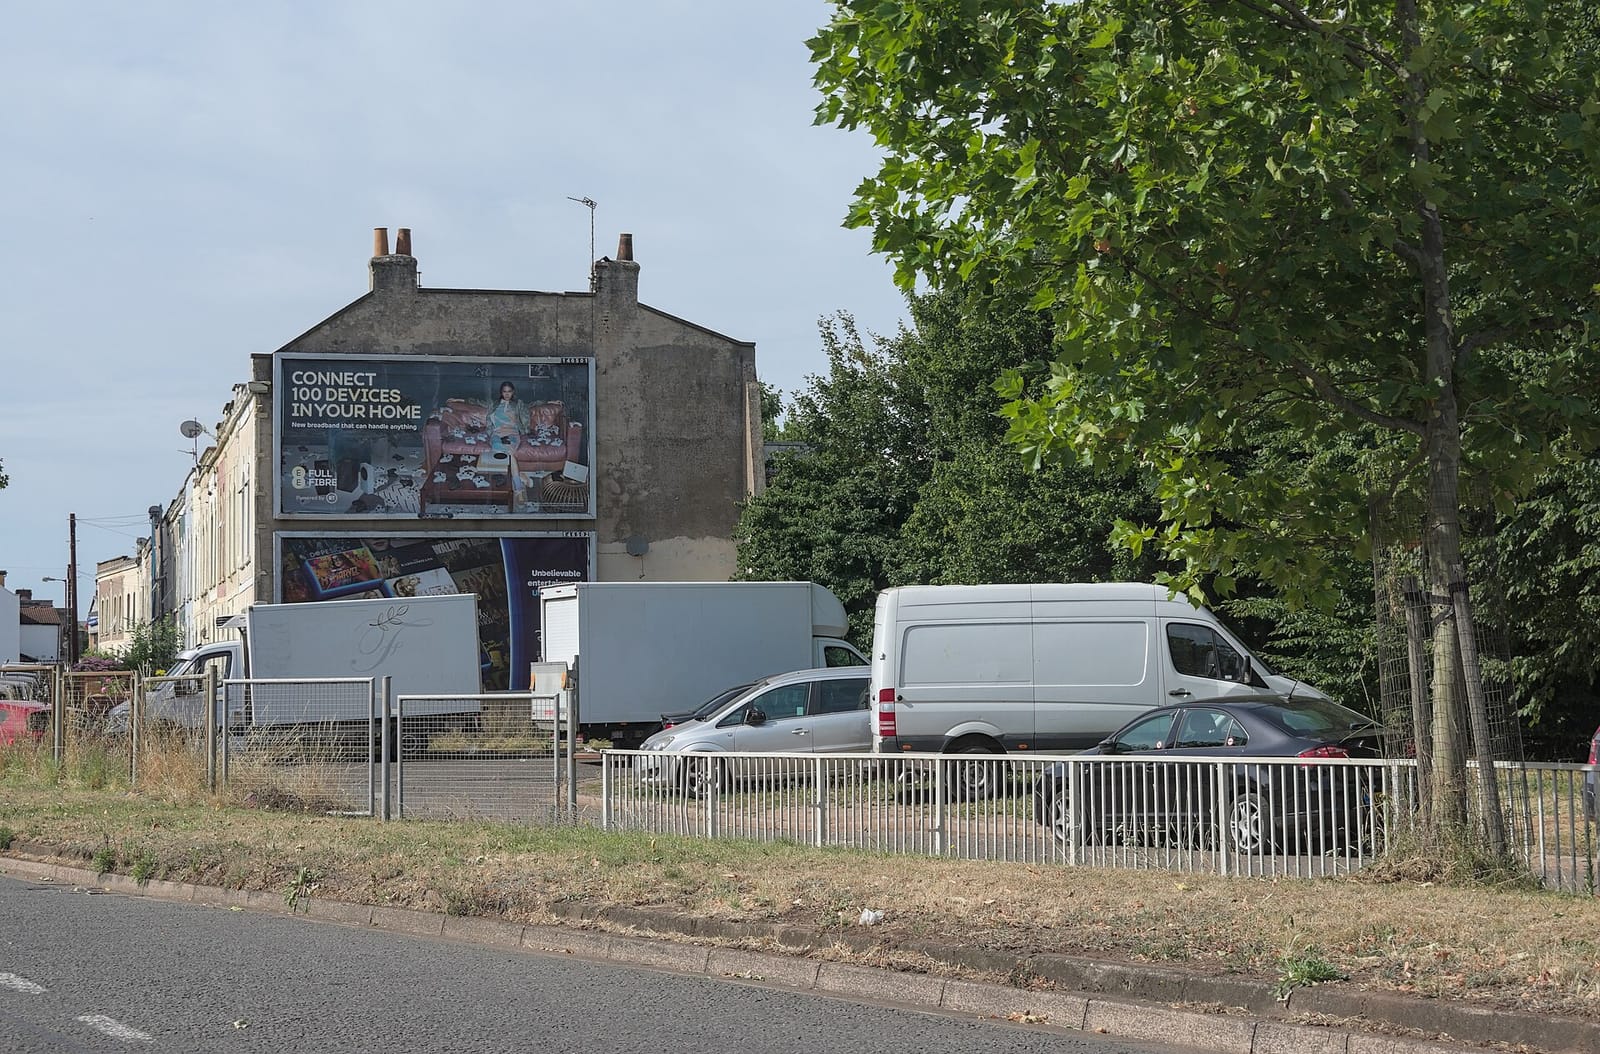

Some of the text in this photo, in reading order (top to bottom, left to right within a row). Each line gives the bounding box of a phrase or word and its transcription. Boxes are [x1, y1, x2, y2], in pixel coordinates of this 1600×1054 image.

[292, 371, 376, 386] CONNECT
[292, 387, 401, 402] 100 DEVICES
[292, 403, 421, 419] IN YOUR HOME
[390, 423, 417, 431] anything
[309, 469, 333, 477] FULL
[532, 569, 581, 577] Unbelievable
